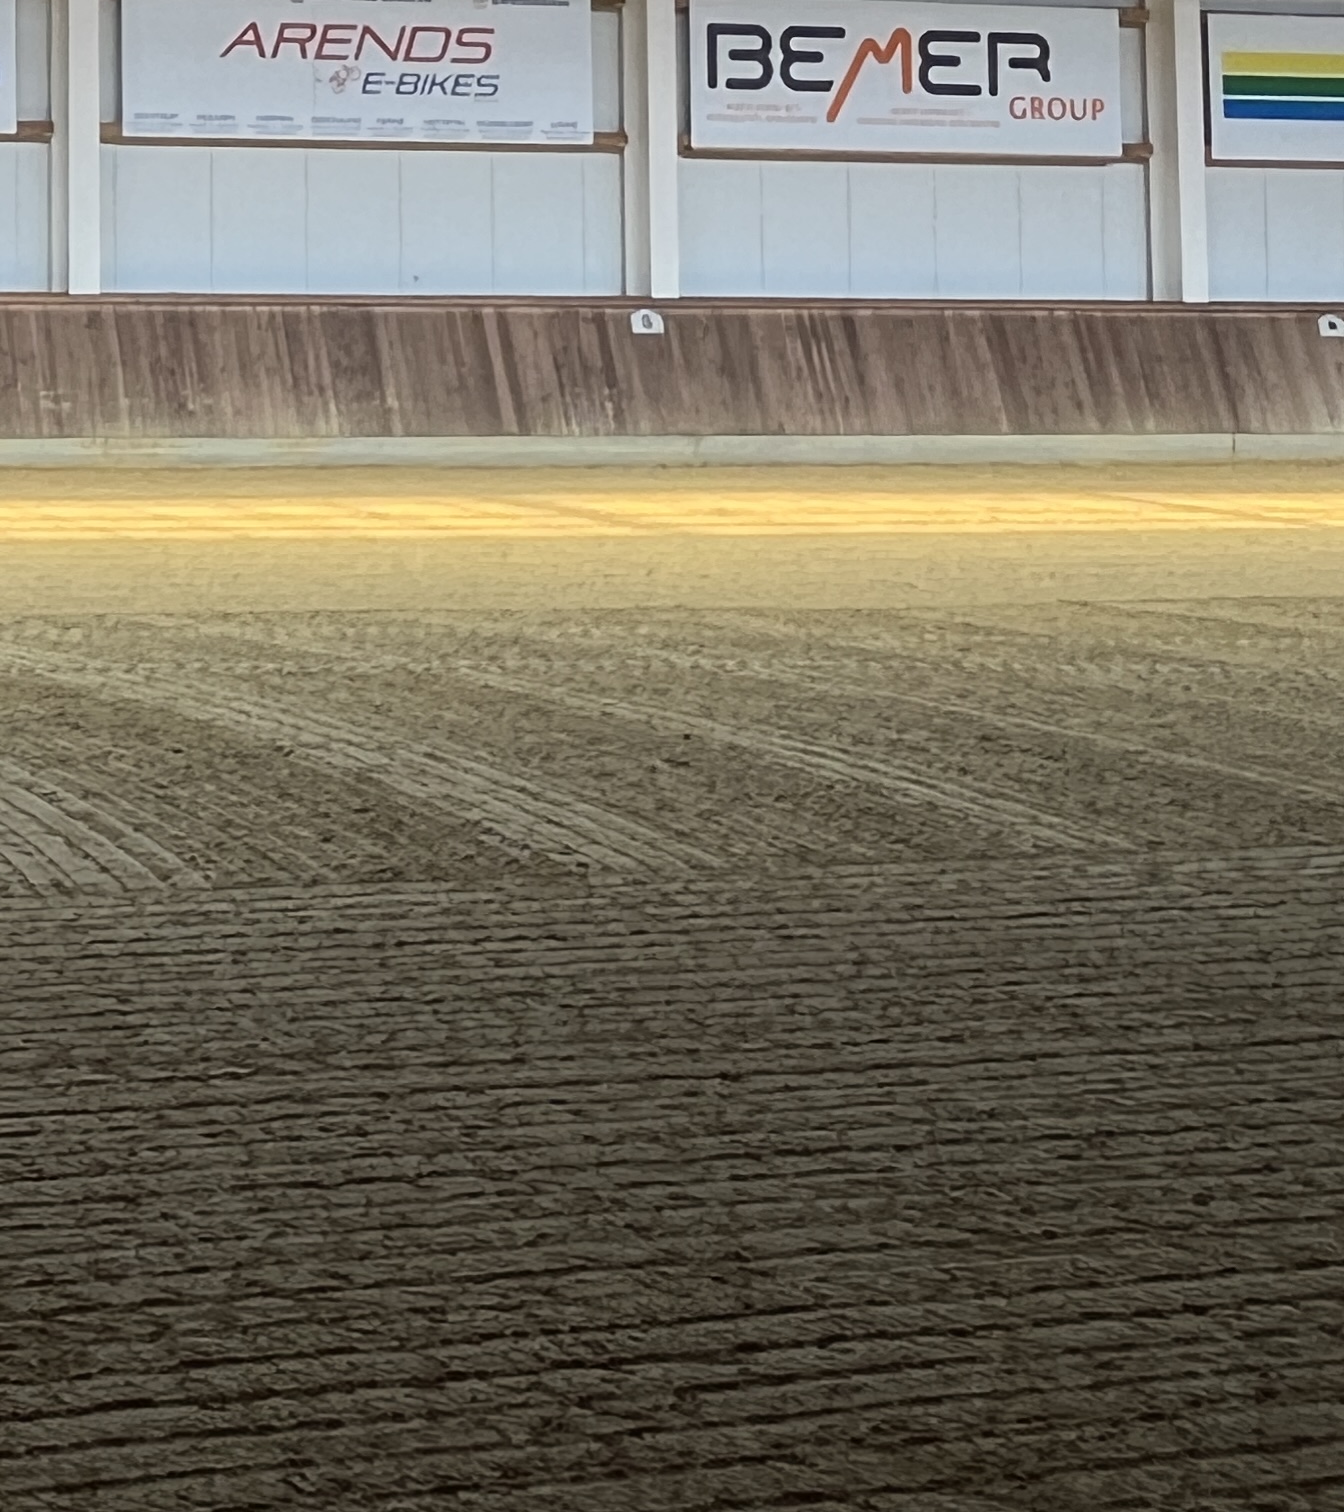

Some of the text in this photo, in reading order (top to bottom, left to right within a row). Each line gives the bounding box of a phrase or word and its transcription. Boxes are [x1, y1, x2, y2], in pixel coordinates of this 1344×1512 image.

[219, 21, 496, 64] ARENDS
[361, 71, 500, 97] E-BIKES
[707, 22, 1051, 123] BEMER
[1008, 96, 1105, 122] GROUP
